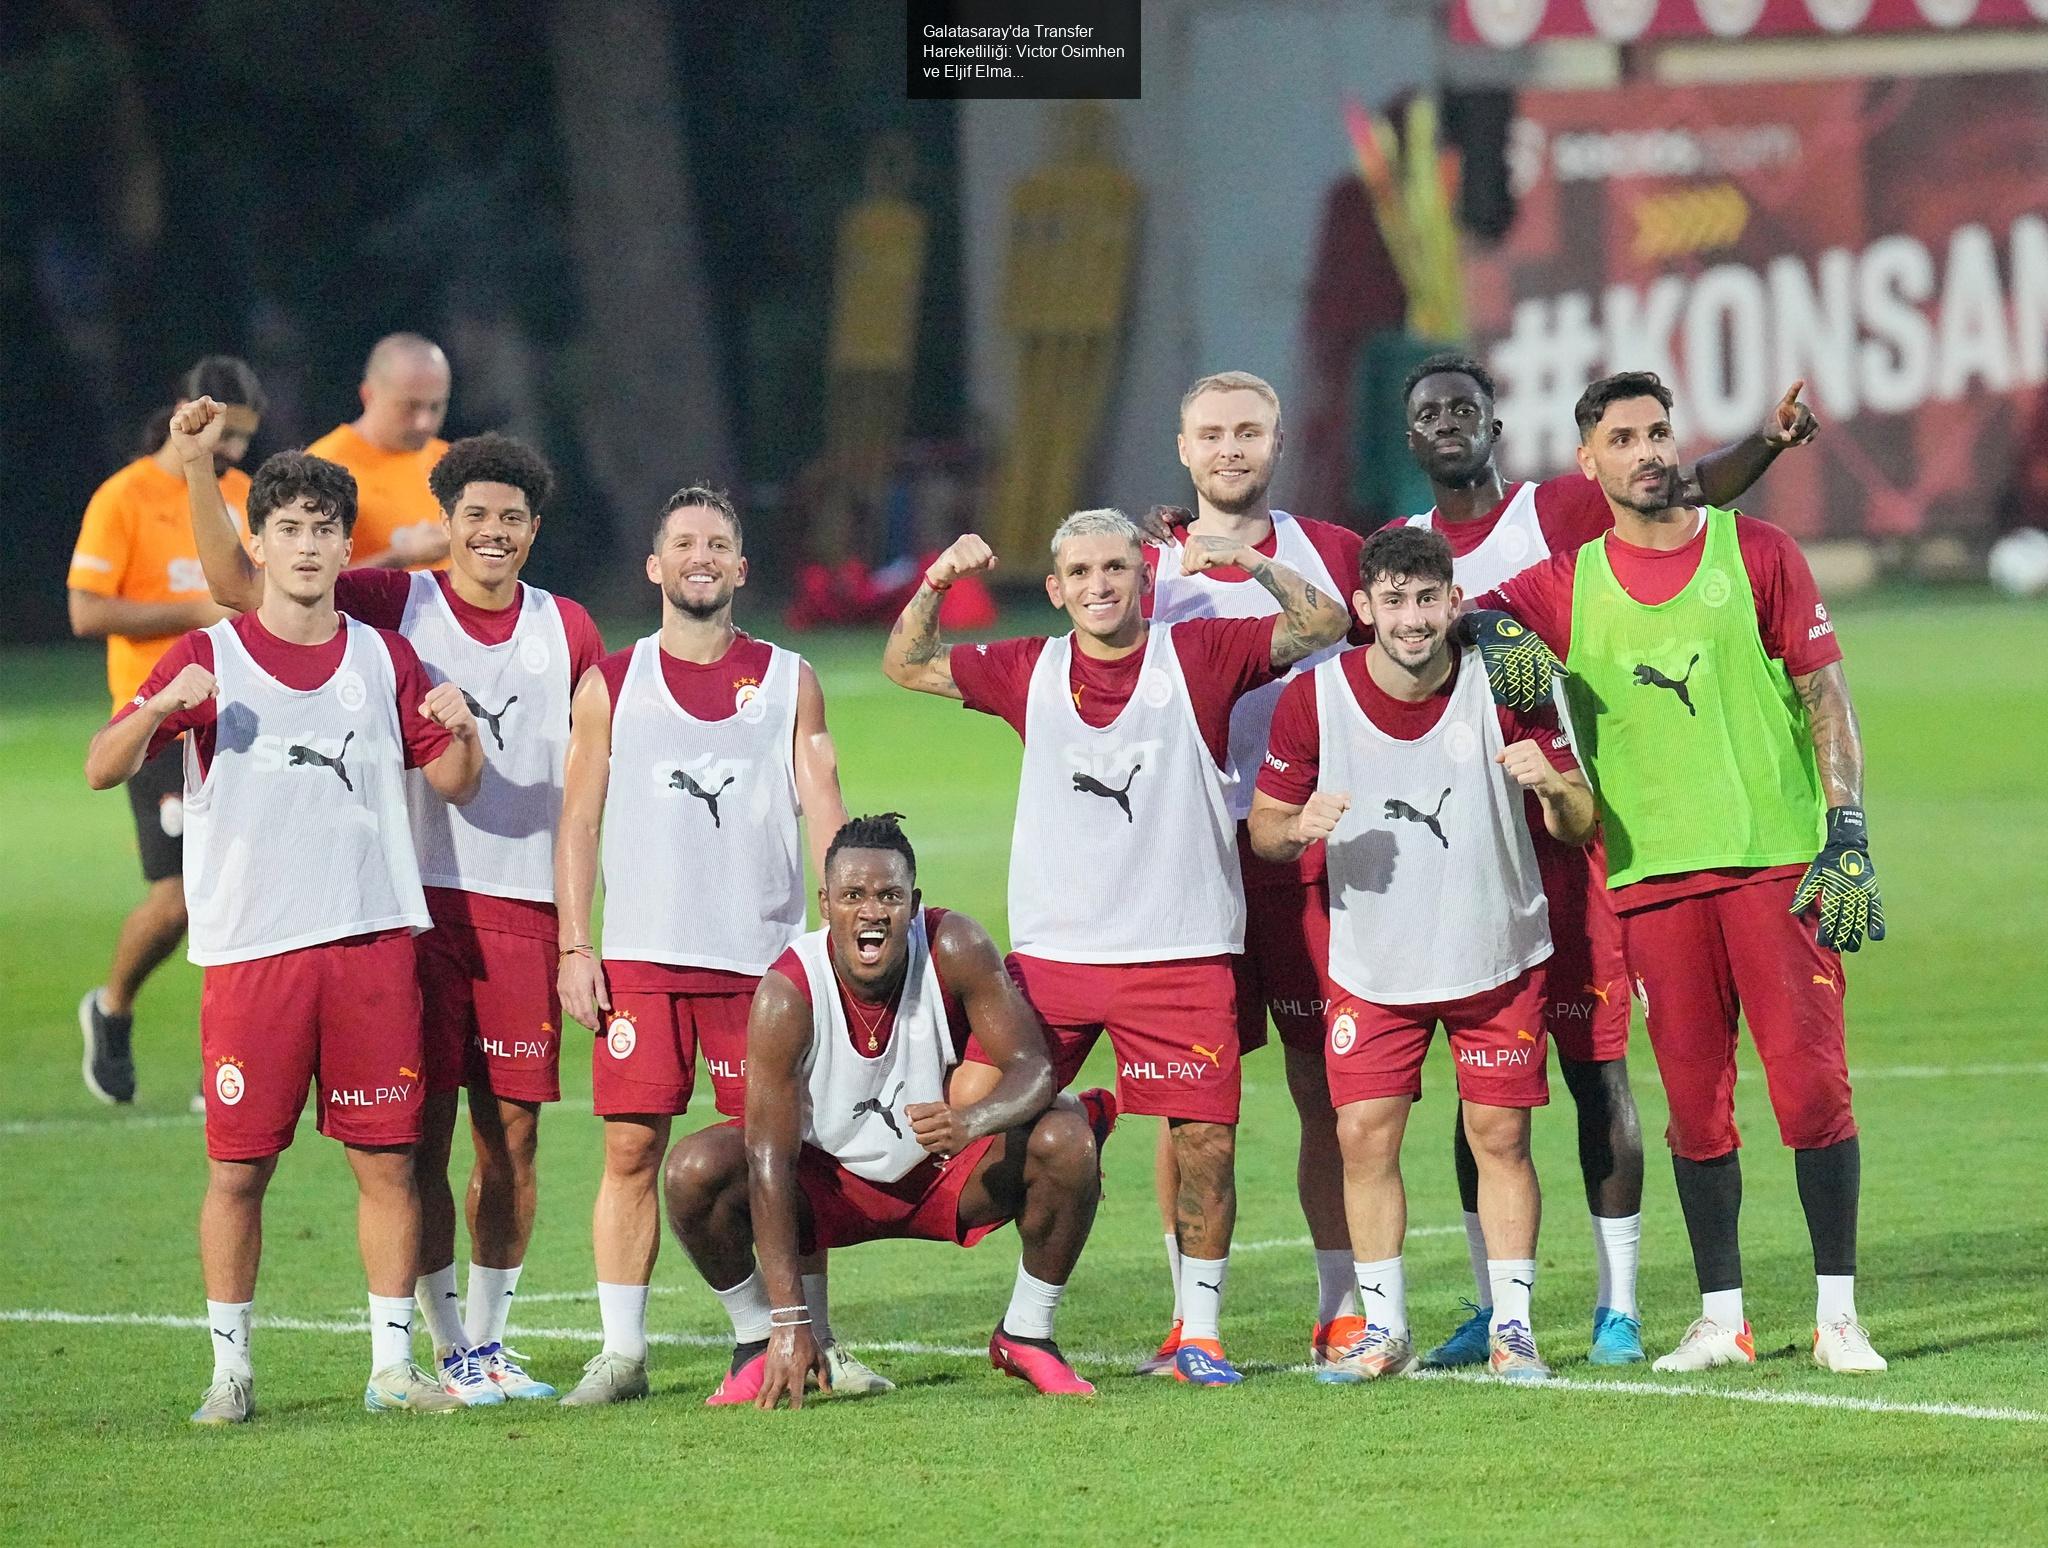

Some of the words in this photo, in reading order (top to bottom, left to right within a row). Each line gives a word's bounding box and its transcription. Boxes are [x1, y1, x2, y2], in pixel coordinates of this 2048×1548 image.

[1556, 1002, 1592, 1019] PAY
[514, 1040, 549, 1058] PAY
[1459, 1048, 1494, 1067] AHL
[1496, 1047, 1531, 1067] PAY
[1121, 1062, 1165, 1079] AHL
[1167, 1062, 1207, 1079] PAY
[330, 1089, 373, 1106] AHL
[375, 1083, 411, 1105] PAY
